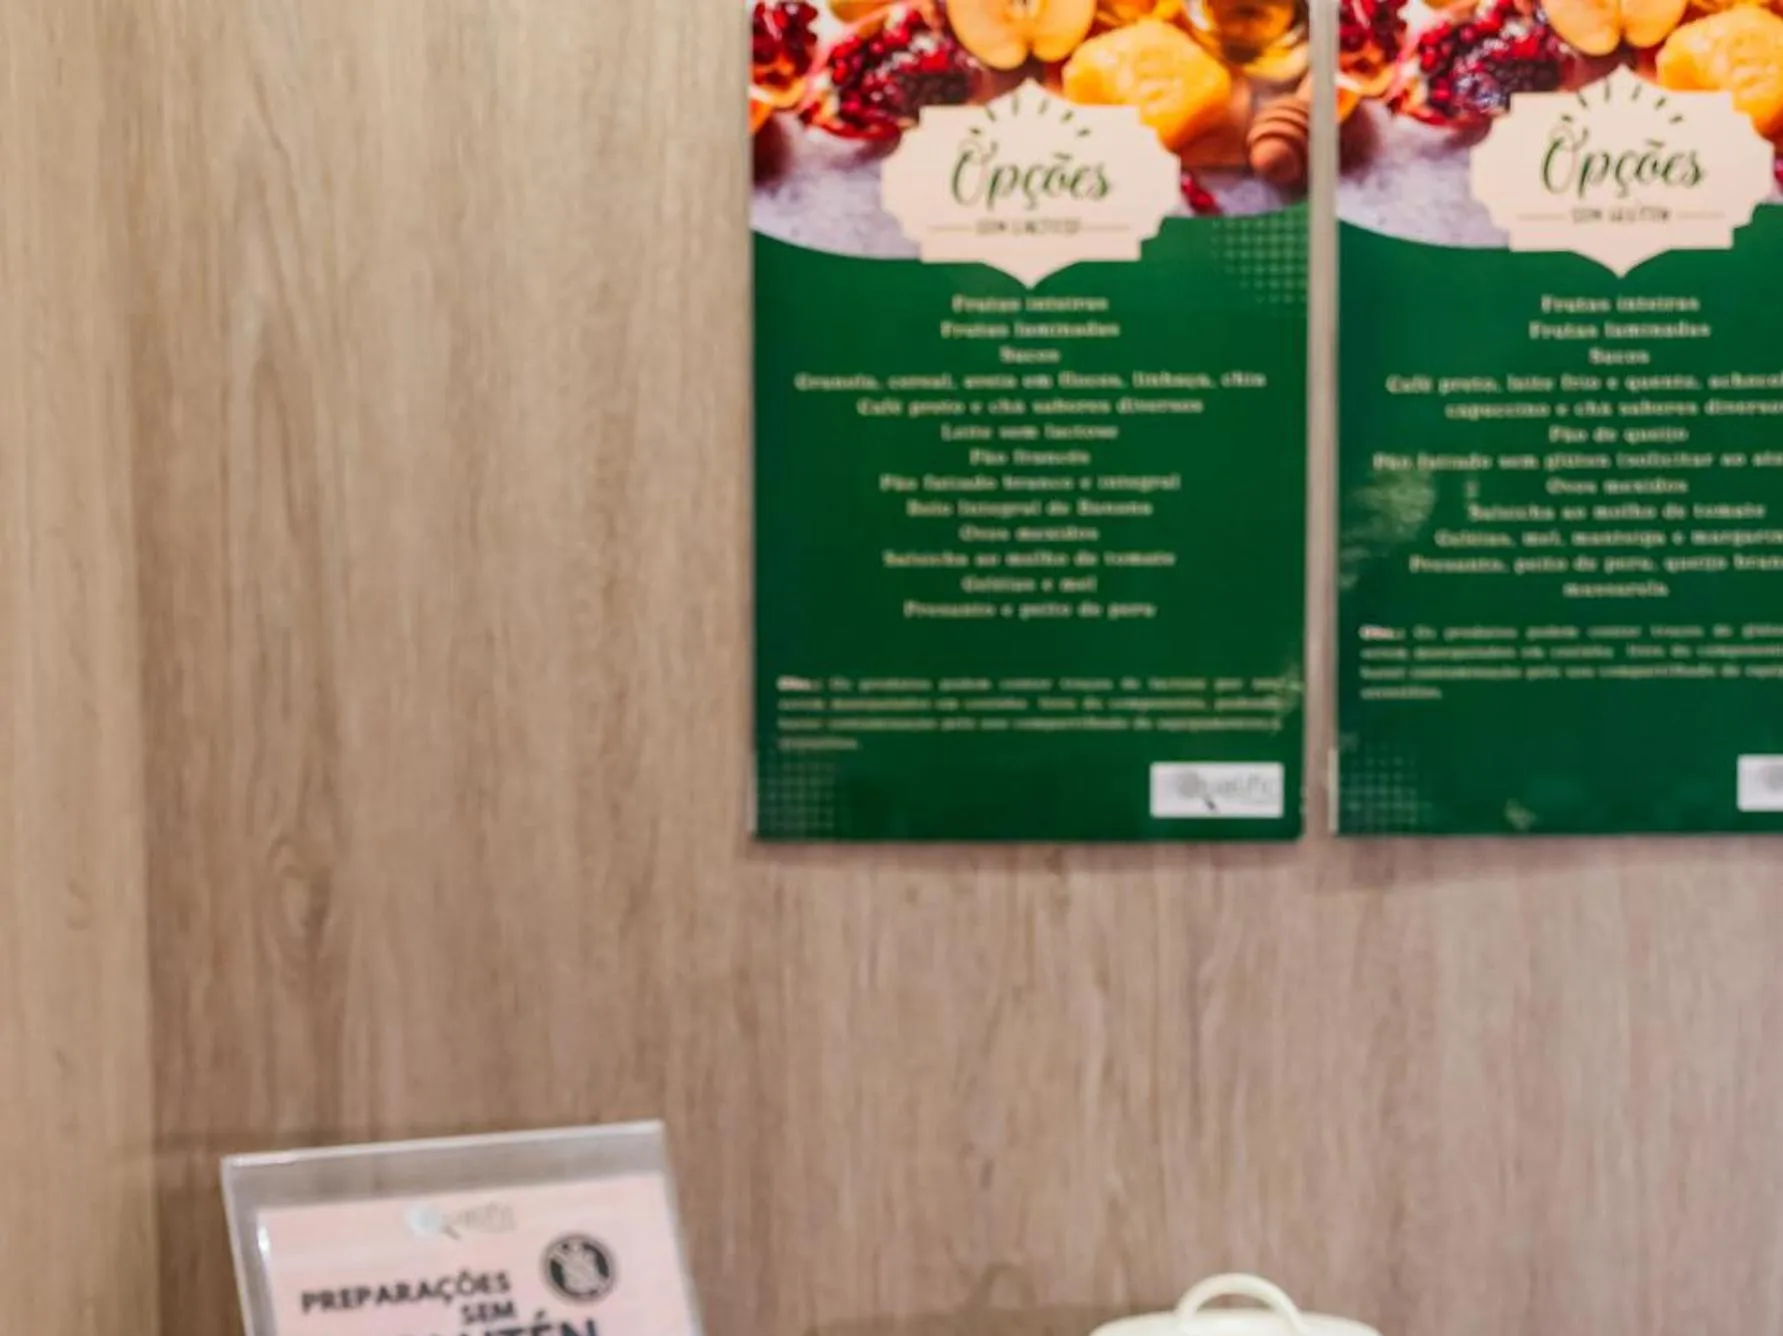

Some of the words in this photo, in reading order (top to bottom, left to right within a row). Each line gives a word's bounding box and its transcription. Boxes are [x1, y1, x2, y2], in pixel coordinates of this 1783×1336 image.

[951, 139, 1114, 211] Opções
[1541, 125, 1706, 198] Opções
[302, 1270, 512, 1314] PREPARAÇÕES
[461, 1301, 517, 1325] SEM
